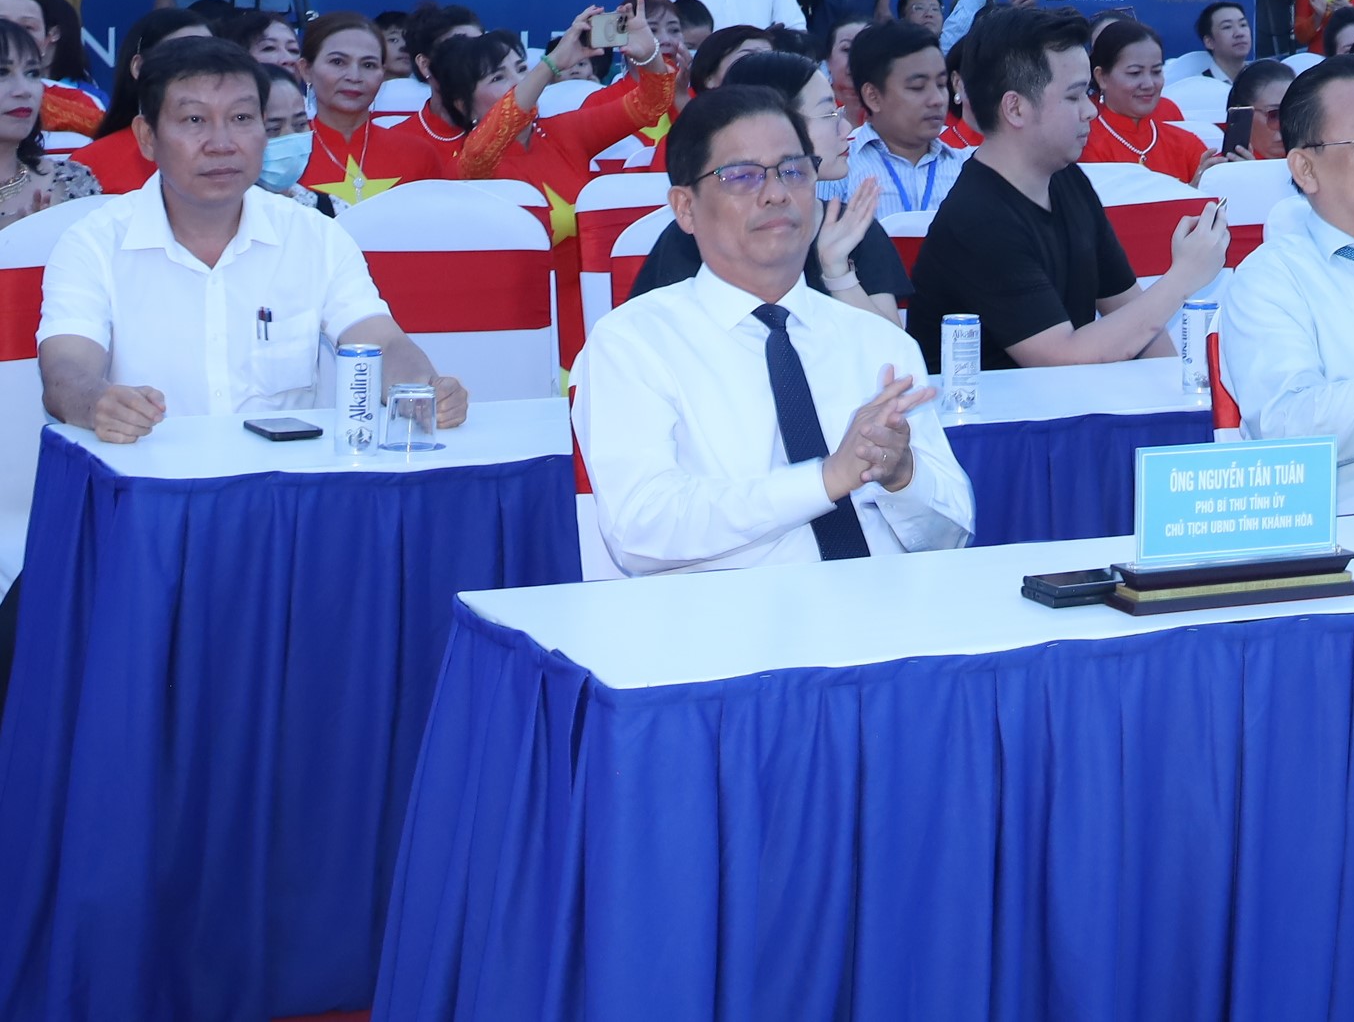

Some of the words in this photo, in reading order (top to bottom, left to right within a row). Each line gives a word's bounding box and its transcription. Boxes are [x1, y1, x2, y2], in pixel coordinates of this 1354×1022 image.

[349, 362, 368, 423] Alkaline
[1170, 468, 1193, 492] ÔNG
[1198, 461, 1244, 490] NGUYỄN
[1248, 459, 1271, 486] TẤN
[1274, 460, 1305, 485] TUÂN
[1195, 498, 1214, 514] PHÓ
[1217, 497, 1227, 512] BÍ
[1229, 497, 1246, 511] THƯ
[1250, 493, 1270, 510] TỈNH
[1273, 492, 1286, 508] ỦY
[1166, 519, 1184, 537] CHỦ
[1187, 521, 1208, 538] TỊCH
[1211, 519, 1235, 533] UBND
[1238, 515, 1259, 531] TỈNH
[1262, 514, 1292, 530] KHÁNH
[1295, 511, 1313, 527] HÒA
